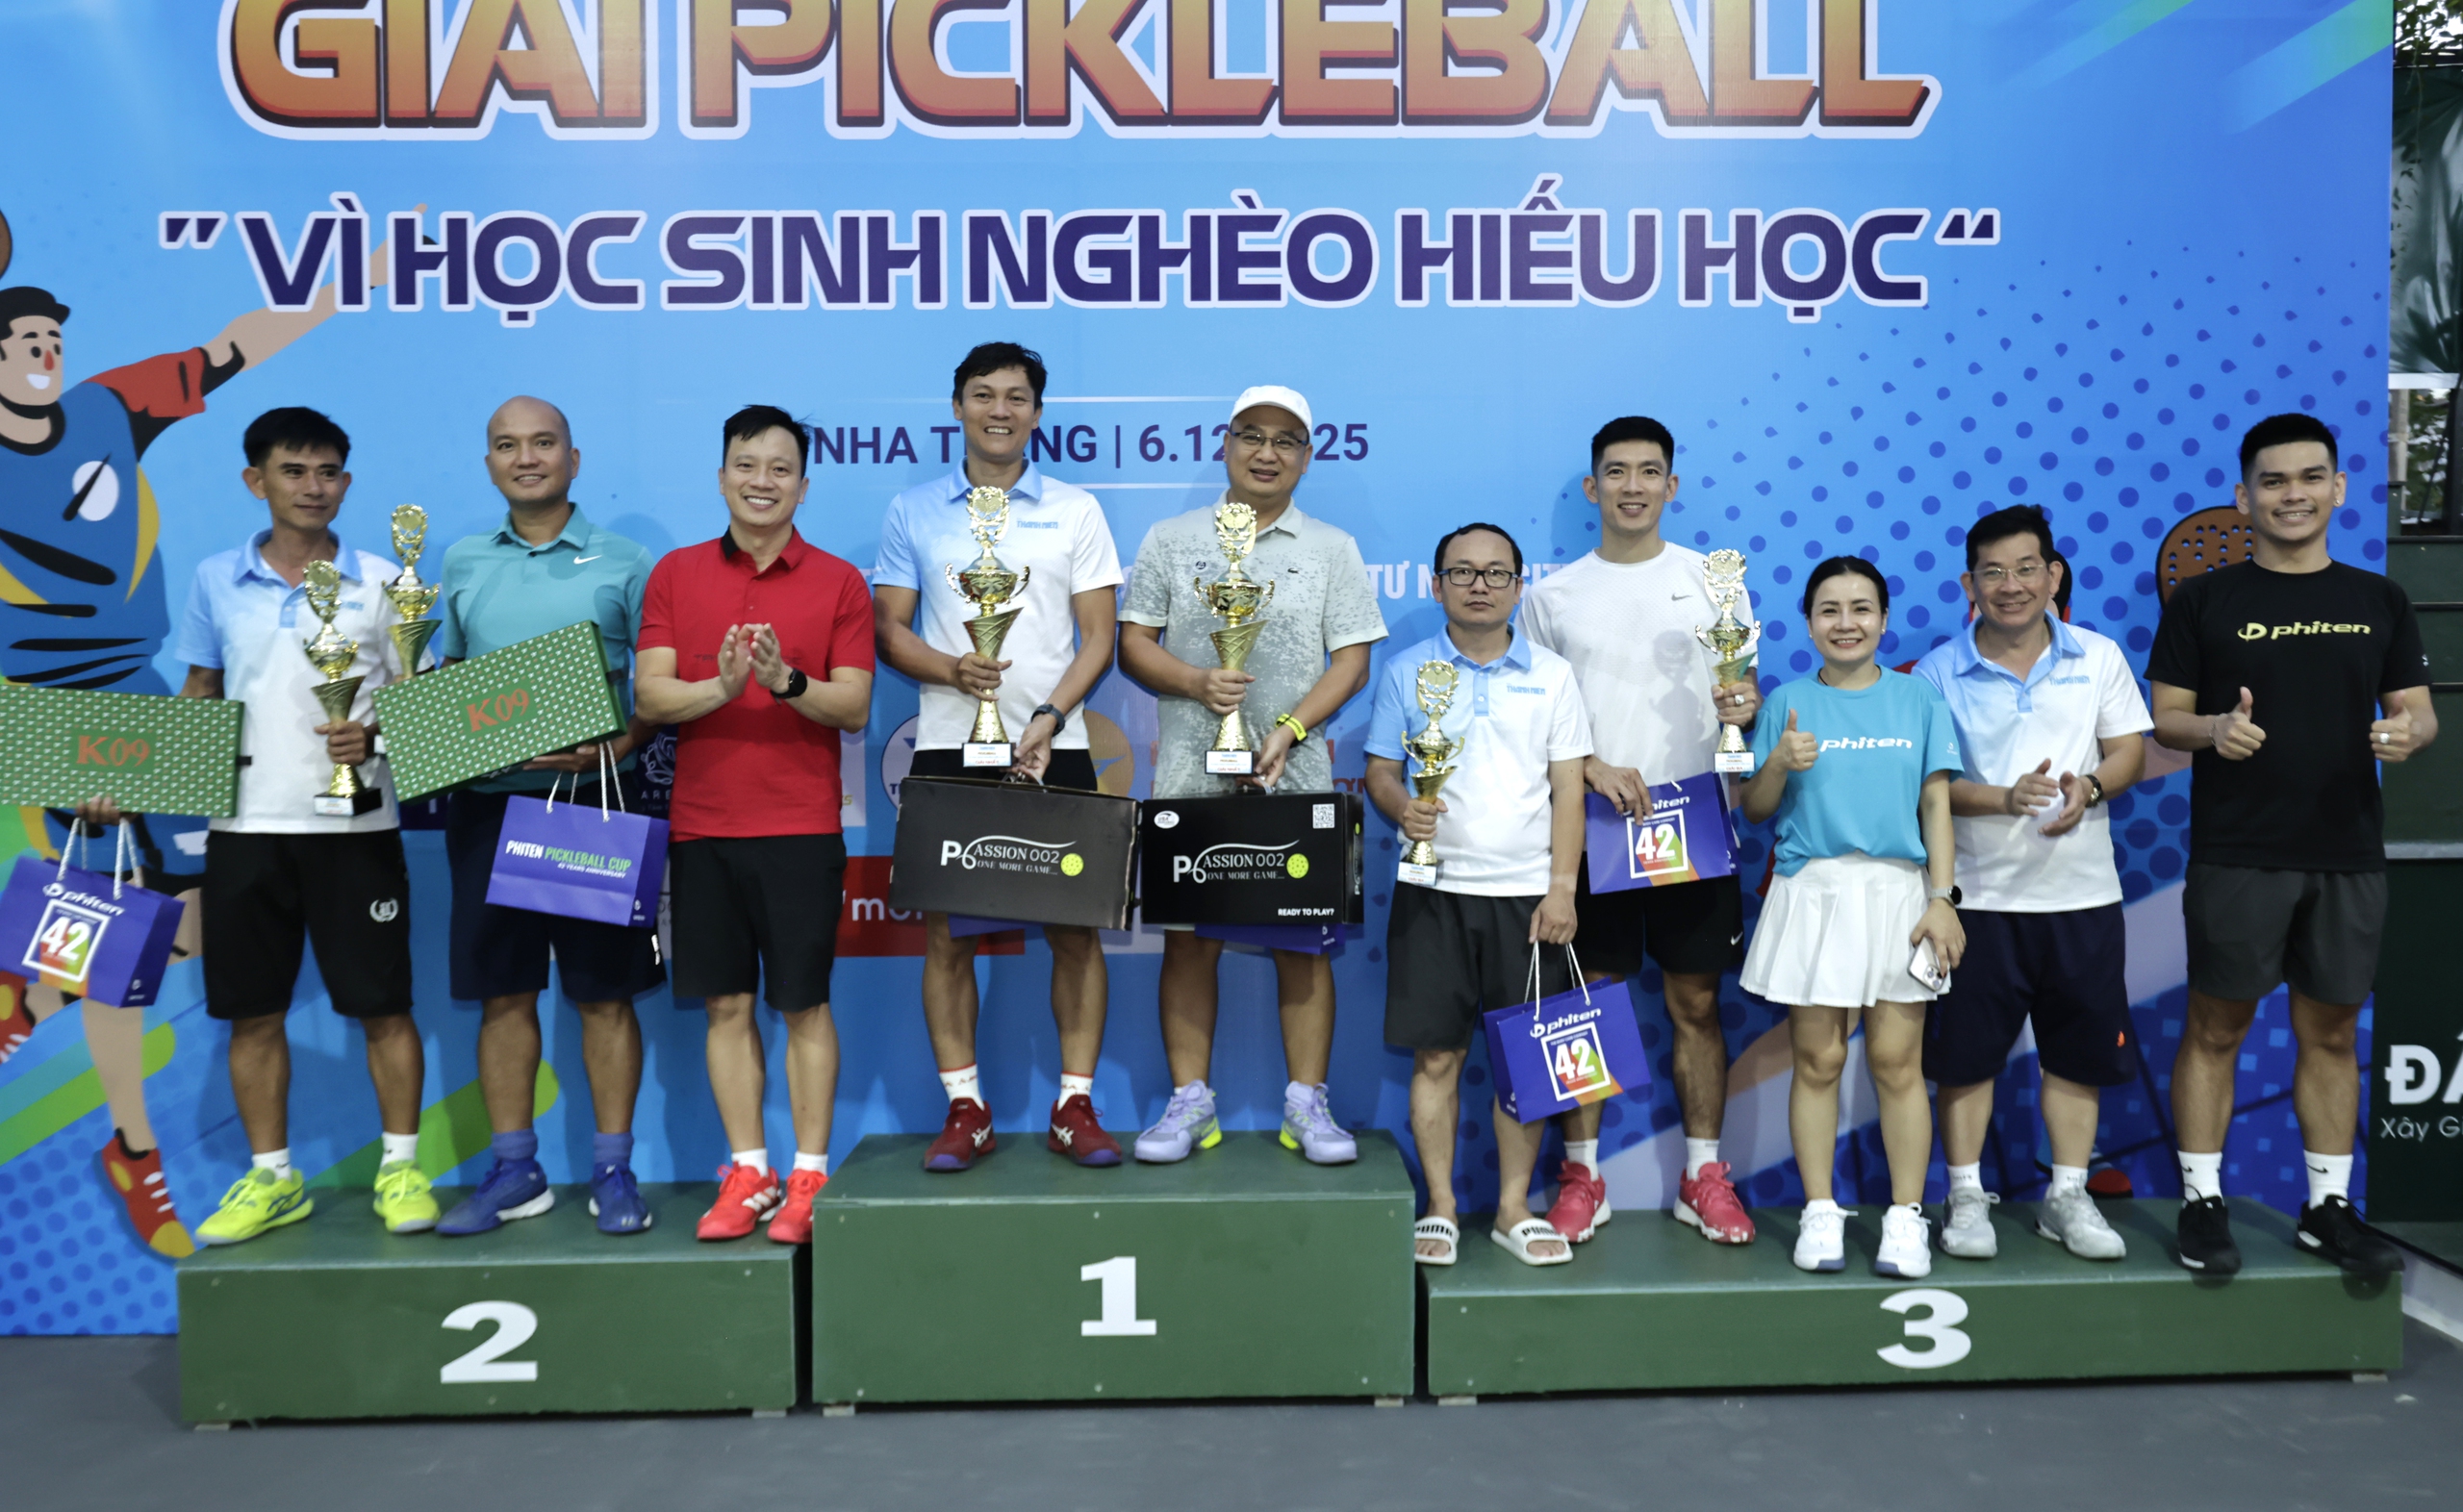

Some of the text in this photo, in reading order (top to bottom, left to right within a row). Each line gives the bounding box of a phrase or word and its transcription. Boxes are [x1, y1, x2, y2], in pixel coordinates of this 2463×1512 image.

[394, 214, 643, 322] HỌC
[667, 214, 942, 306] SINH
[968, 194, 1375, 304] NGHÈO
[1400, 179, 1657, 304] HIẾU
[814, 426, 918, 465] NHA
[930, 425, 1097, 464] TNG
[2271, 620, 2372, 641] phiten
[466, 688, 529, 733] K09
[76, 735, 150, 768] K09
[1819, 736, 1913, 753] phiten
[505, 840, 632, 872] PHITEN PICKLEBALL CUP
[1636, 823, 1676, 861] 42
[585, 867, 626, 878] ANNIVERSARY
[977, 860, 996, 869] ONE
[999, 861, 1024, 872] MORE
[1206, 870, 1226, 880] ONE
[1228, 870, 1251, 880] MORE
[60, 891, 125, 917] phiten
[40, 917, 91, 961] 42
[1547, 1008, 1602, 1035] phiten
[1555, 1038, 1596, 1080] 42
[2380, 1116, 2430, 1143] Xây
[1079, 1257, 1157, 1337] 1
[441, 1301, 538, 1384] 2
[1877, 1290, 1970, 1368] 3
